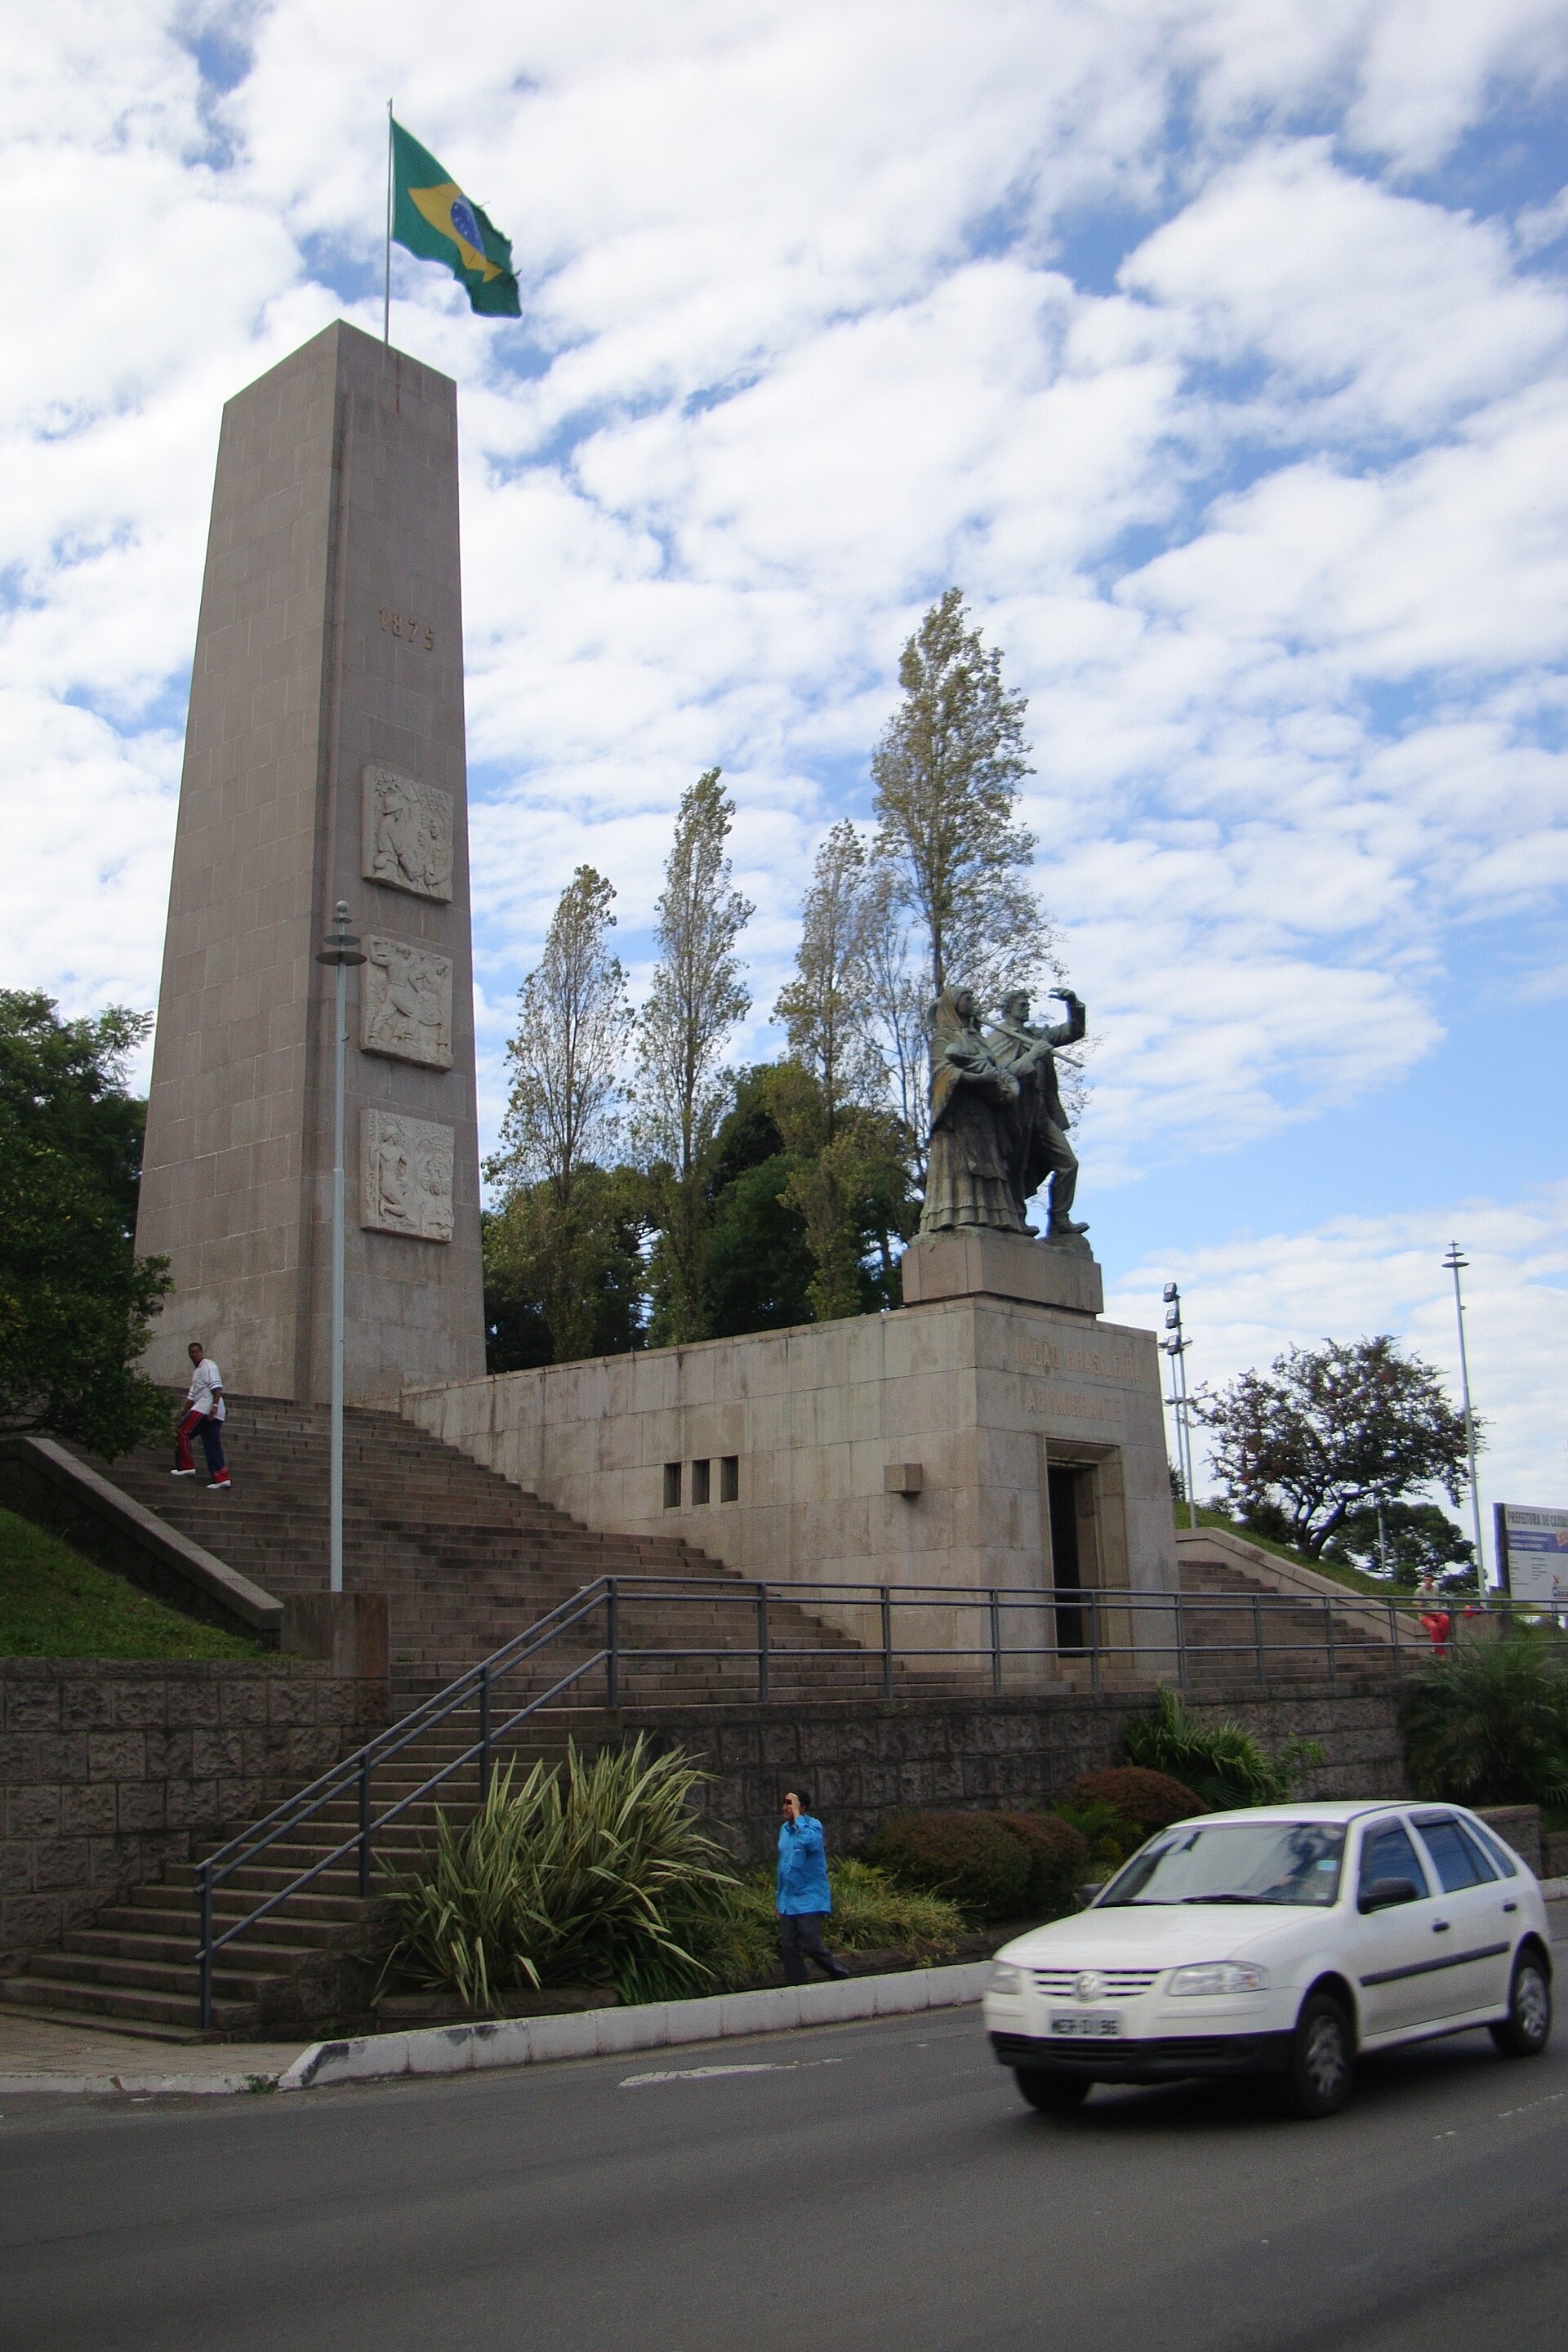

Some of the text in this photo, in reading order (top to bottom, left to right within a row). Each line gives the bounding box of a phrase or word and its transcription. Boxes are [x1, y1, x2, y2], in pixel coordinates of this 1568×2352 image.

[378, 609, 434, 651] 1875
[1508, 1511, 1540, 1526] PREFEITURA
[1543, 1514, 1549, 1526] DE
